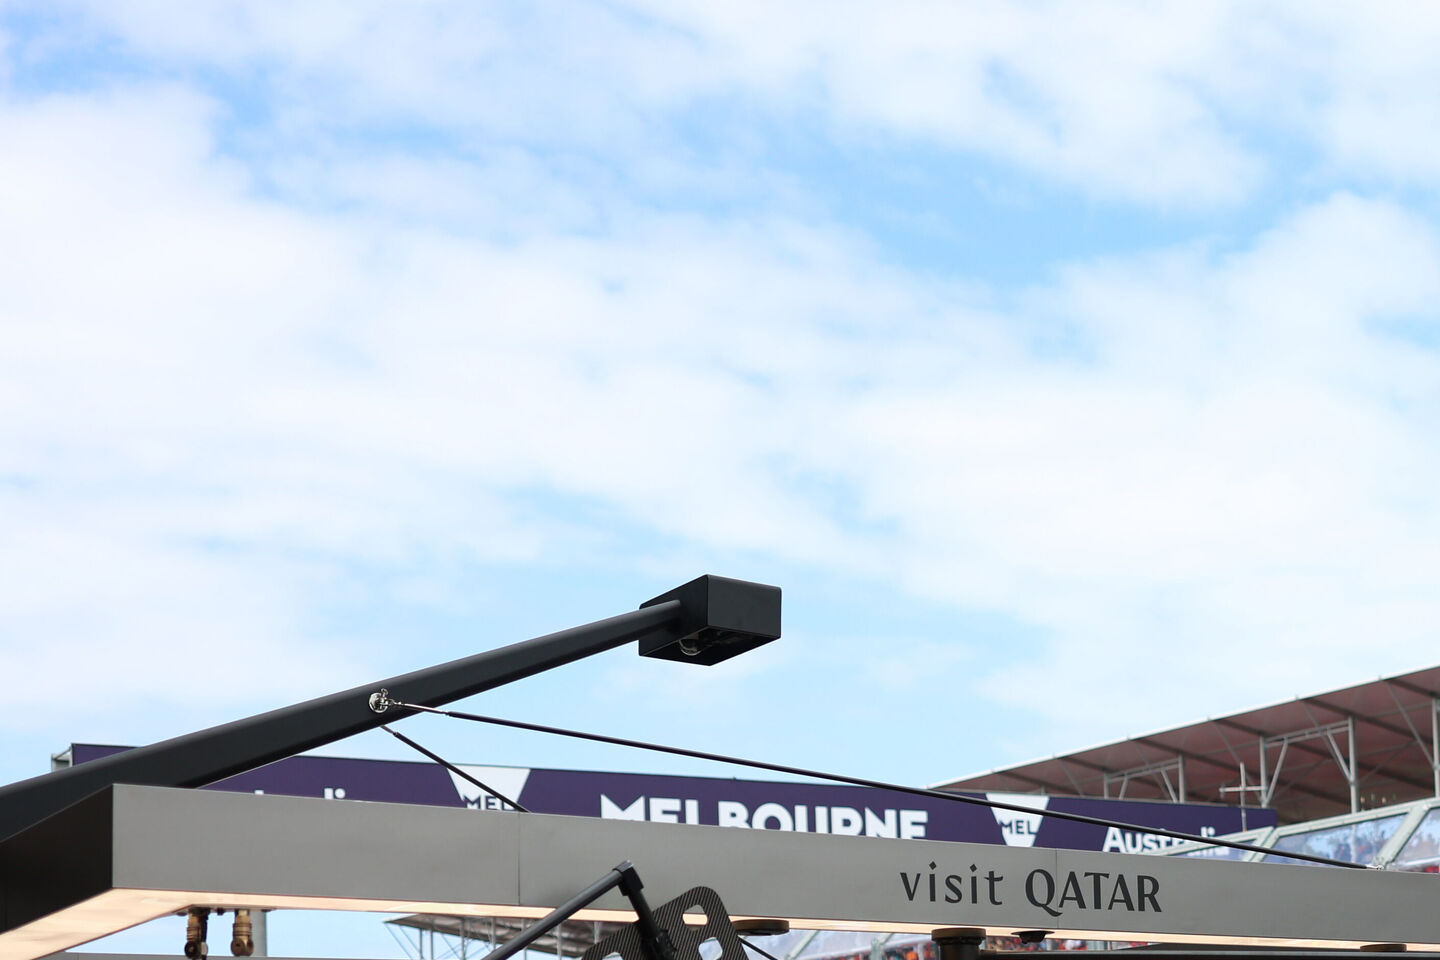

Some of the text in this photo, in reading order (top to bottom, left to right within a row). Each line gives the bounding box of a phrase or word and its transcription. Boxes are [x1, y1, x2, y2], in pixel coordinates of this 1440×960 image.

[1000, 819, 1037, 835] MEL
[899, 861, 1163, 917] visit QATAR
